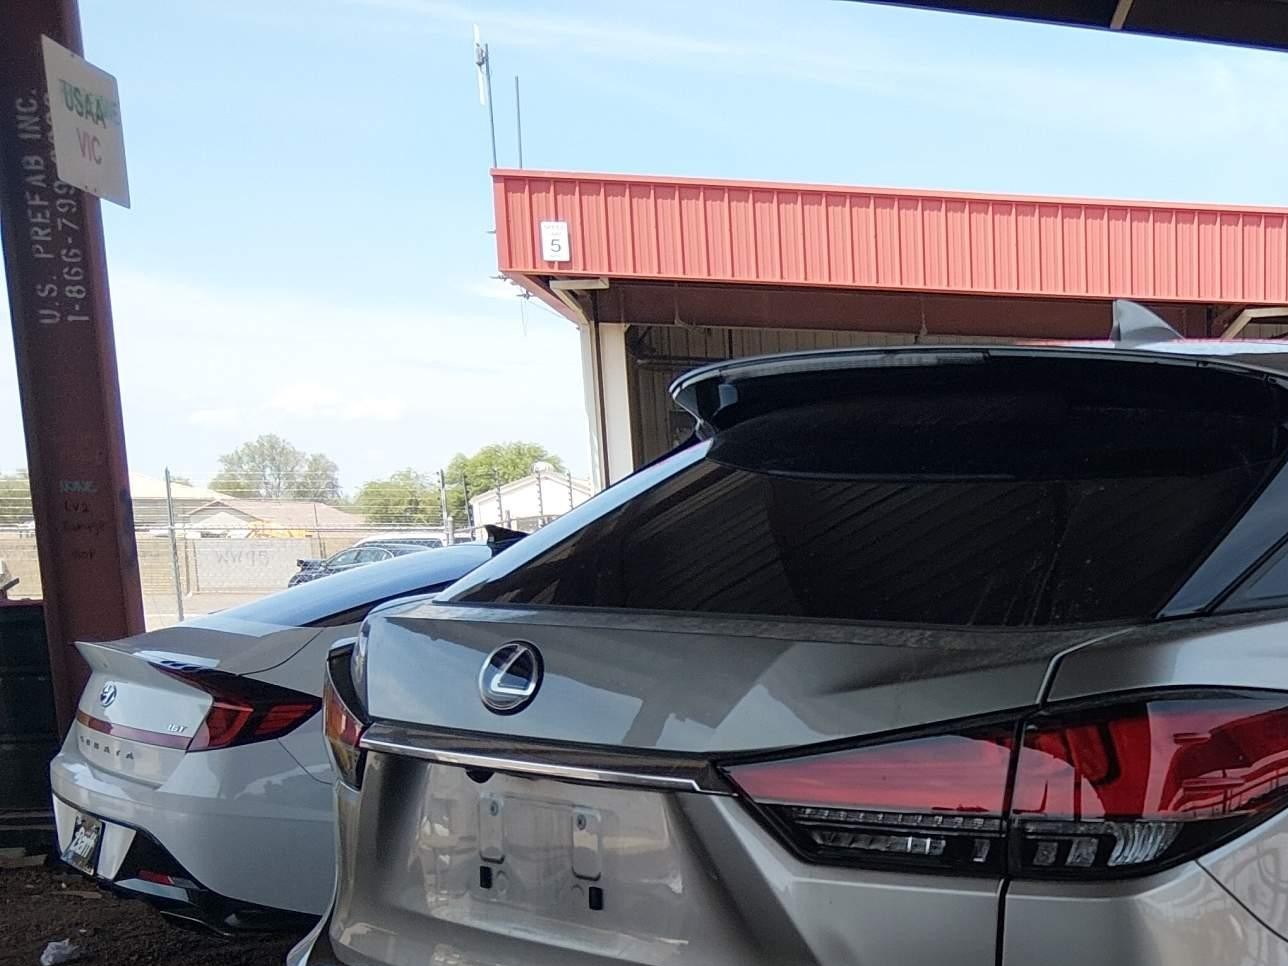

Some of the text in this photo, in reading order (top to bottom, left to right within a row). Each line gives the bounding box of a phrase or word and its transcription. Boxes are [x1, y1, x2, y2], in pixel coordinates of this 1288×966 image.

[61, 81, 107, 129] USAA
[76, 127, 102, 165] VIC
[15, 88, 61, 325] U.S. PREFAB INC.
[550, 238, 562, 253] 5
